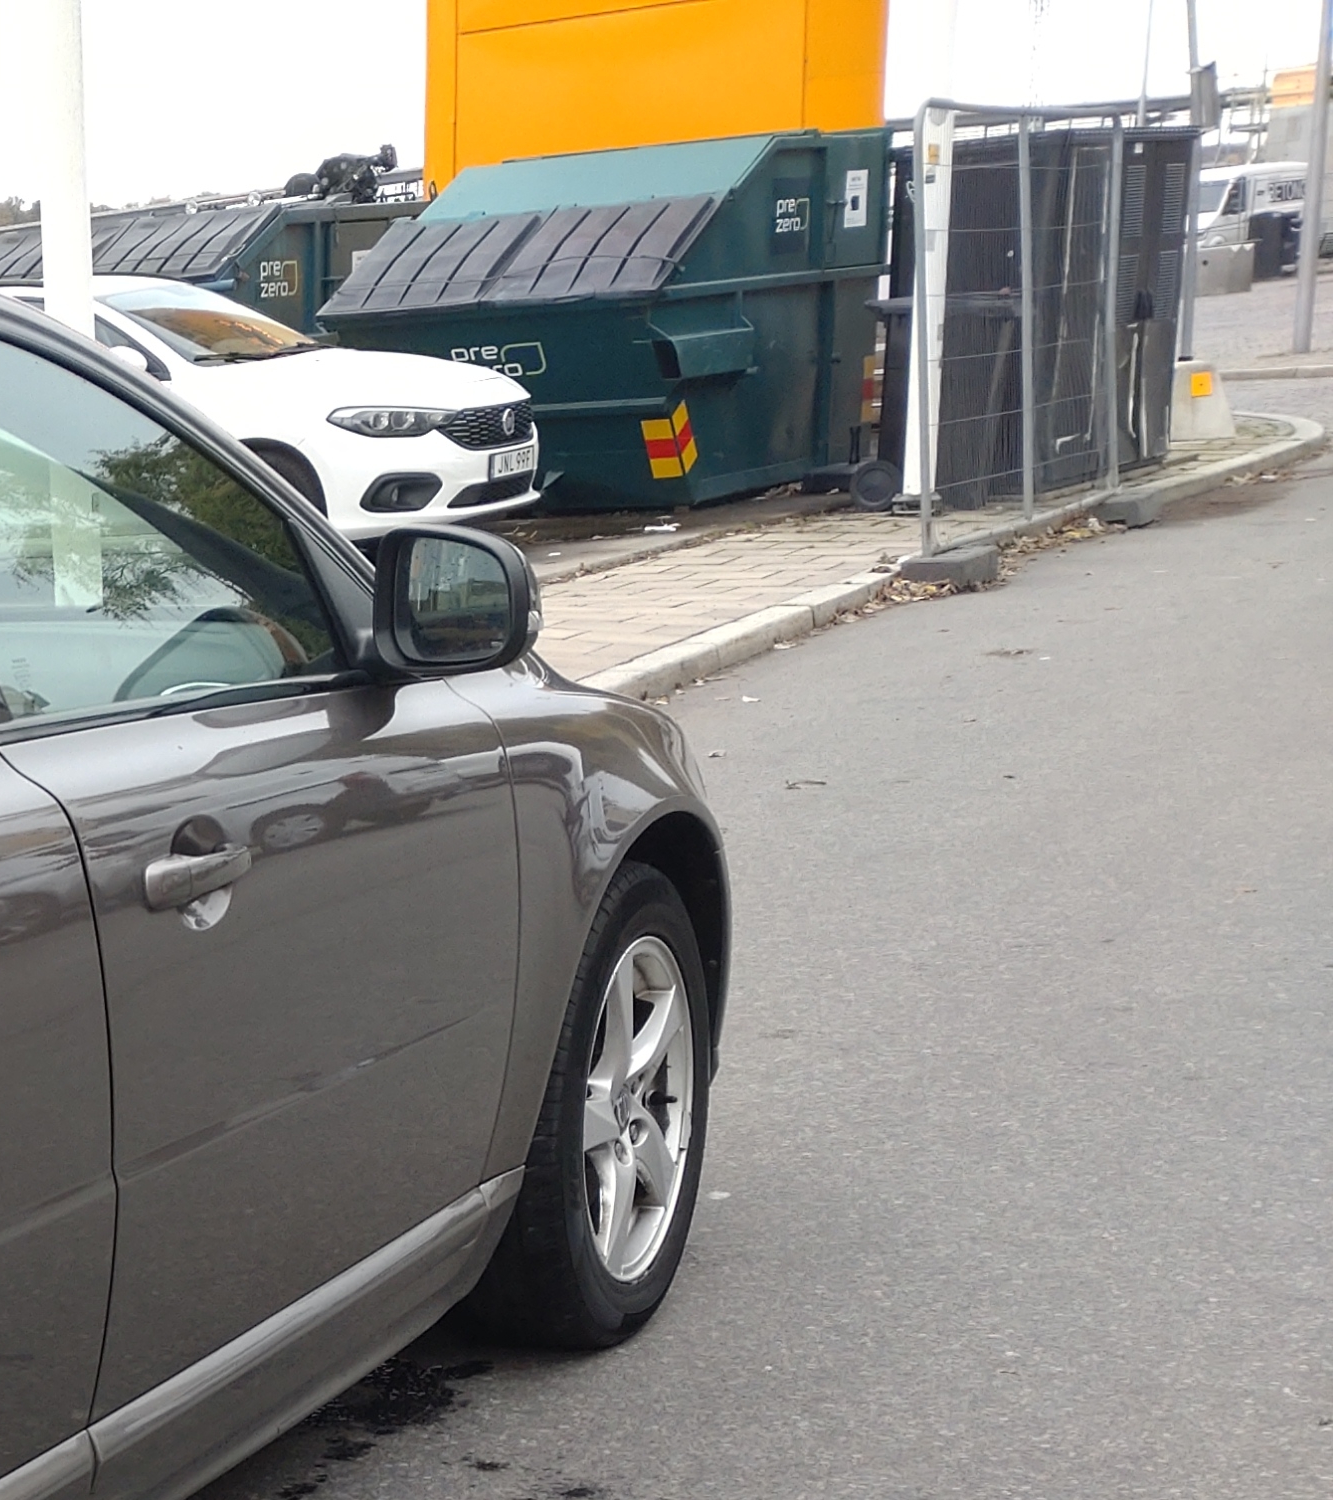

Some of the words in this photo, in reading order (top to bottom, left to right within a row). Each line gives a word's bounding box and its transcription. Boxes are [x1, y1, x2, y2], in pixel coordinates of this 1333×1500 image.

[776, 198, 796, 217] pre
[775, 217, 801, 233] zero
[260, 261, 281, 281] pre
[260, 281, 289, 298] zero
[498, 454, 514, 474] JNL
